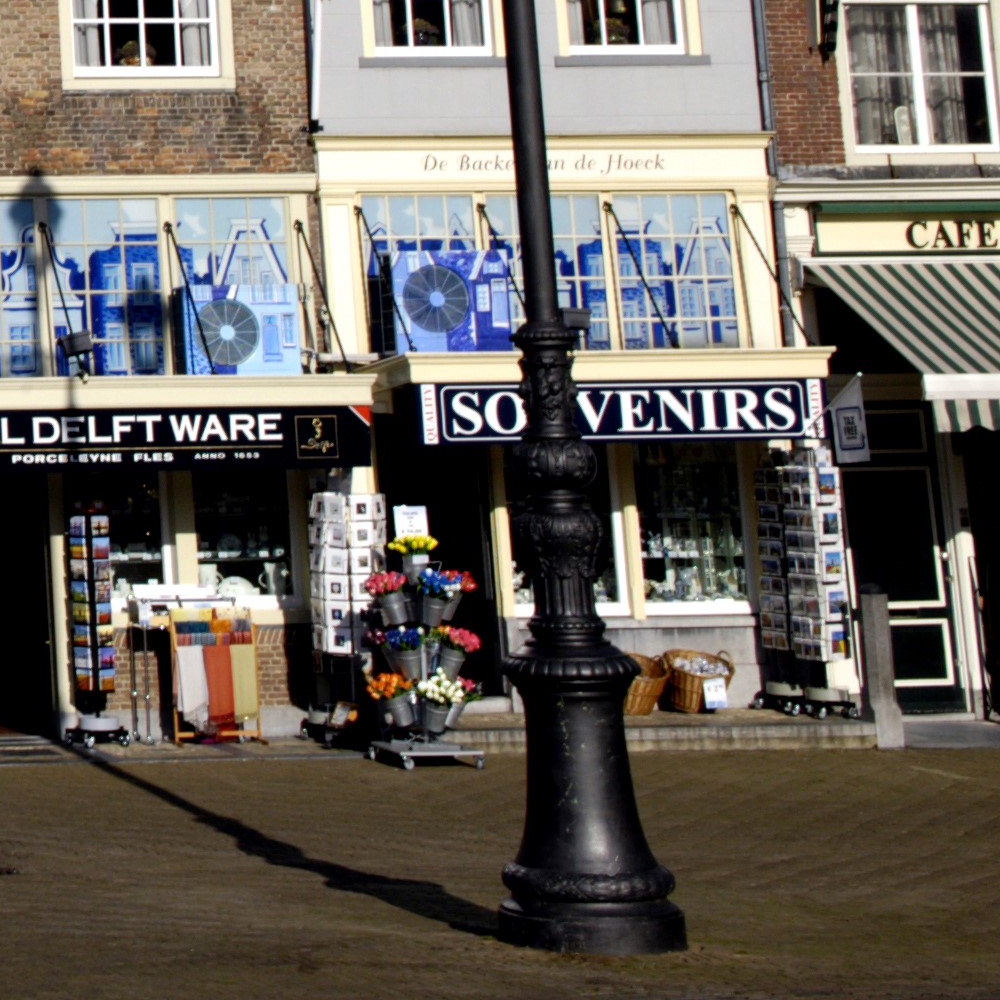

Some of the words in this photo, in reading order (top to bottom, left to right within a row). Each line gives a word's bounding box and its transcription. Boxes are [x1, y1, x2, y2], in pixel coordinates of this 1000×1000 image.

[422, 153, 449, 171] De
[457, 153, 515, 171] Backe
[547, 159, 565, 170] an
[574, 153, 597, 171] de
[904, 220, 999, 249] CAFE
[423, 387, 439, 442] QUALITY
[451, 387, 797, 436] SOVENIRS
[31, 414, 162, 446] DELFT
[168, 412, 284, 443] WARE
[11, 452, 123, 465] PORCELEYNE
[133, 451, 175, 463] FLES
[194, 452, 227, 461] ANNO
